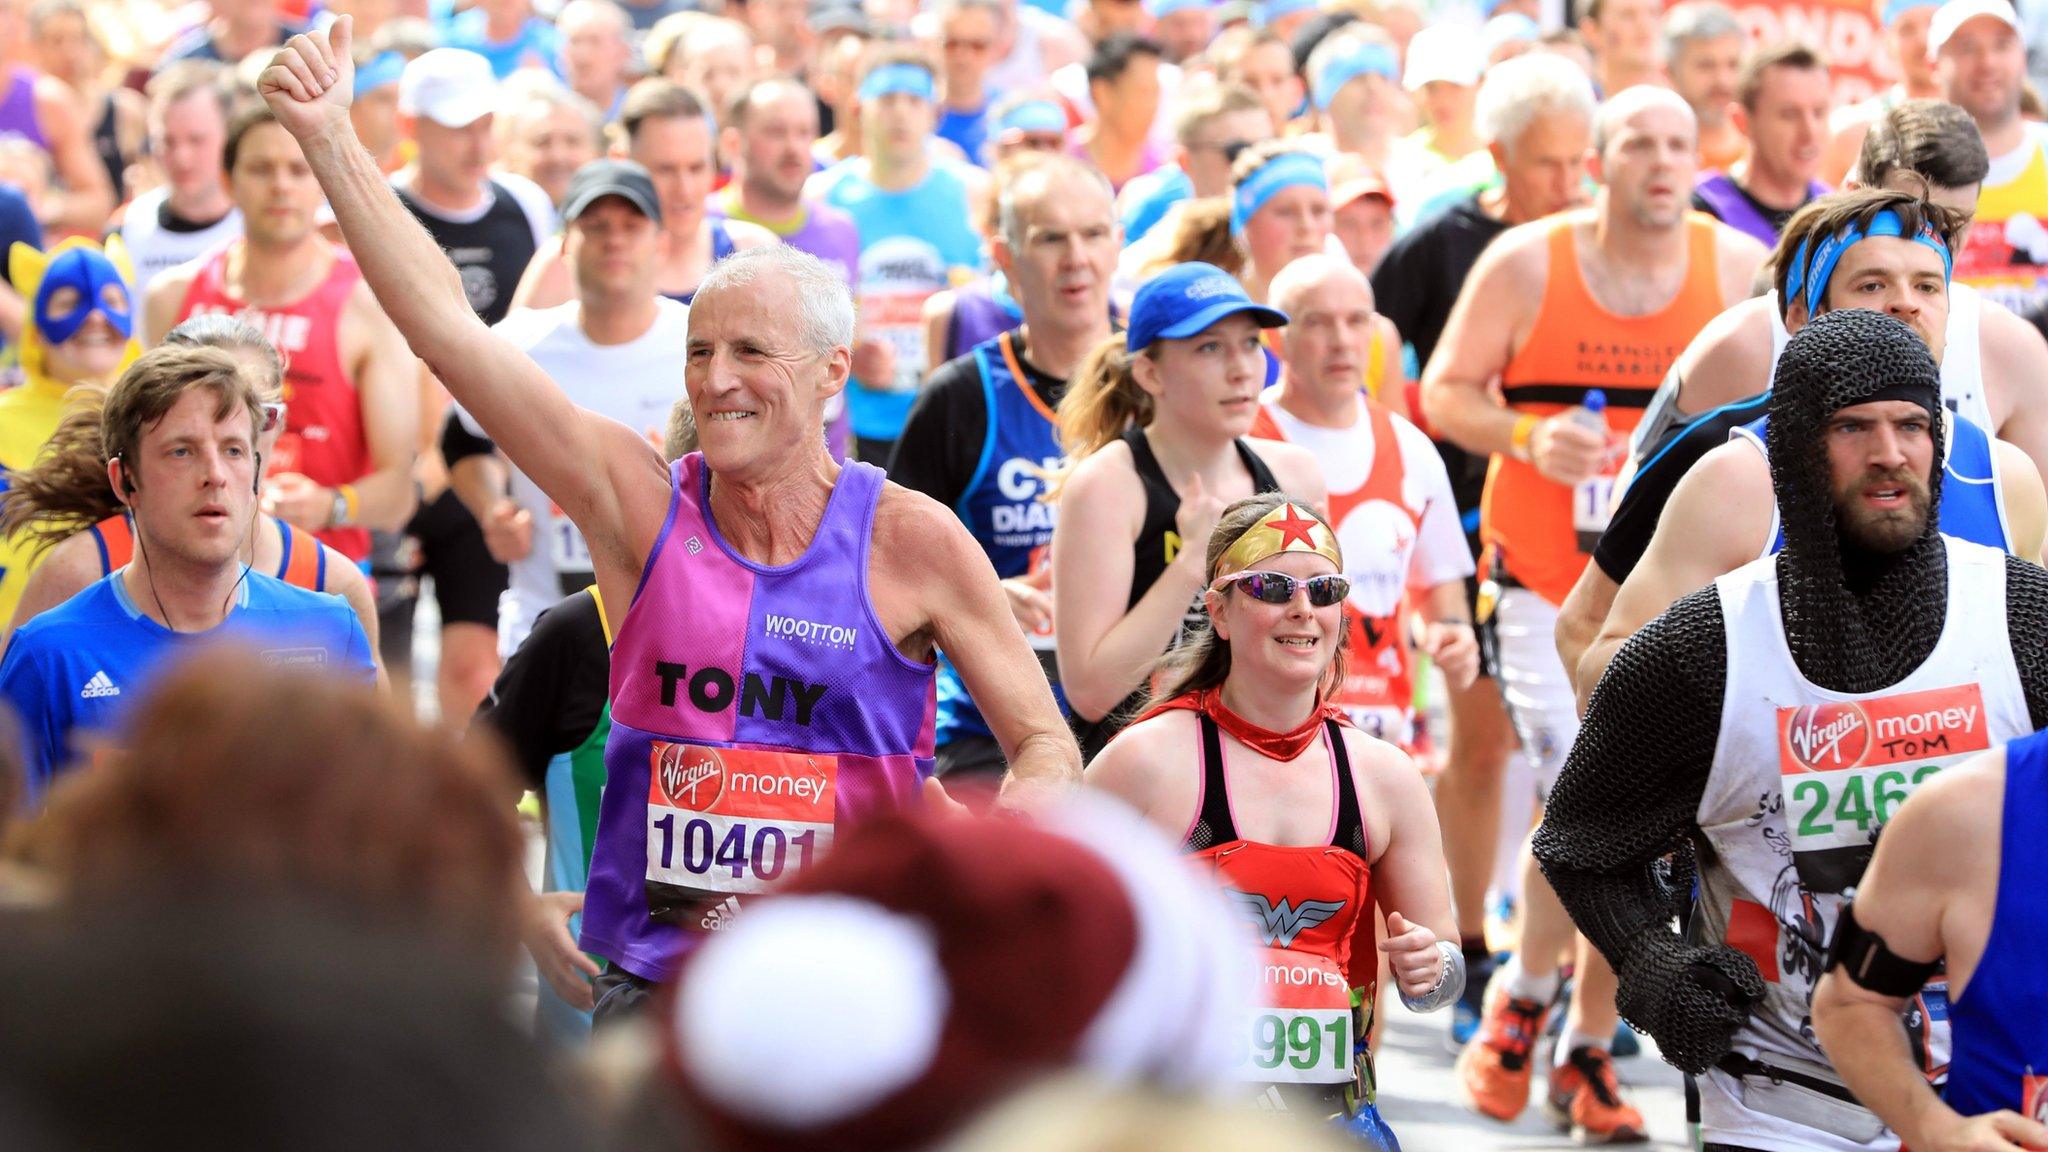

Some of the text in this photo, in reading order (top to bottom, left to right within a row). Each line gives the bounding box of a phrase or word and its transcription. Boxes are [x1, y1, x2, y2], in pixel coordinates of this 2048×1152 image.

[766, 614, 857, 645] WOOTTON
[81, 685, 120, 698] adidas
[655, 661, 828, 727] TONY
[1793, 704, 1977, 764] Virgin money
[1882, 734, 1950, 758] TOM
[663, 745, 827, 805] Virgin money
[653, 813, 816, 881] 10401
[1264, 965, 1349, 993] money
[1238, 1014, 1347, 1070] 991
